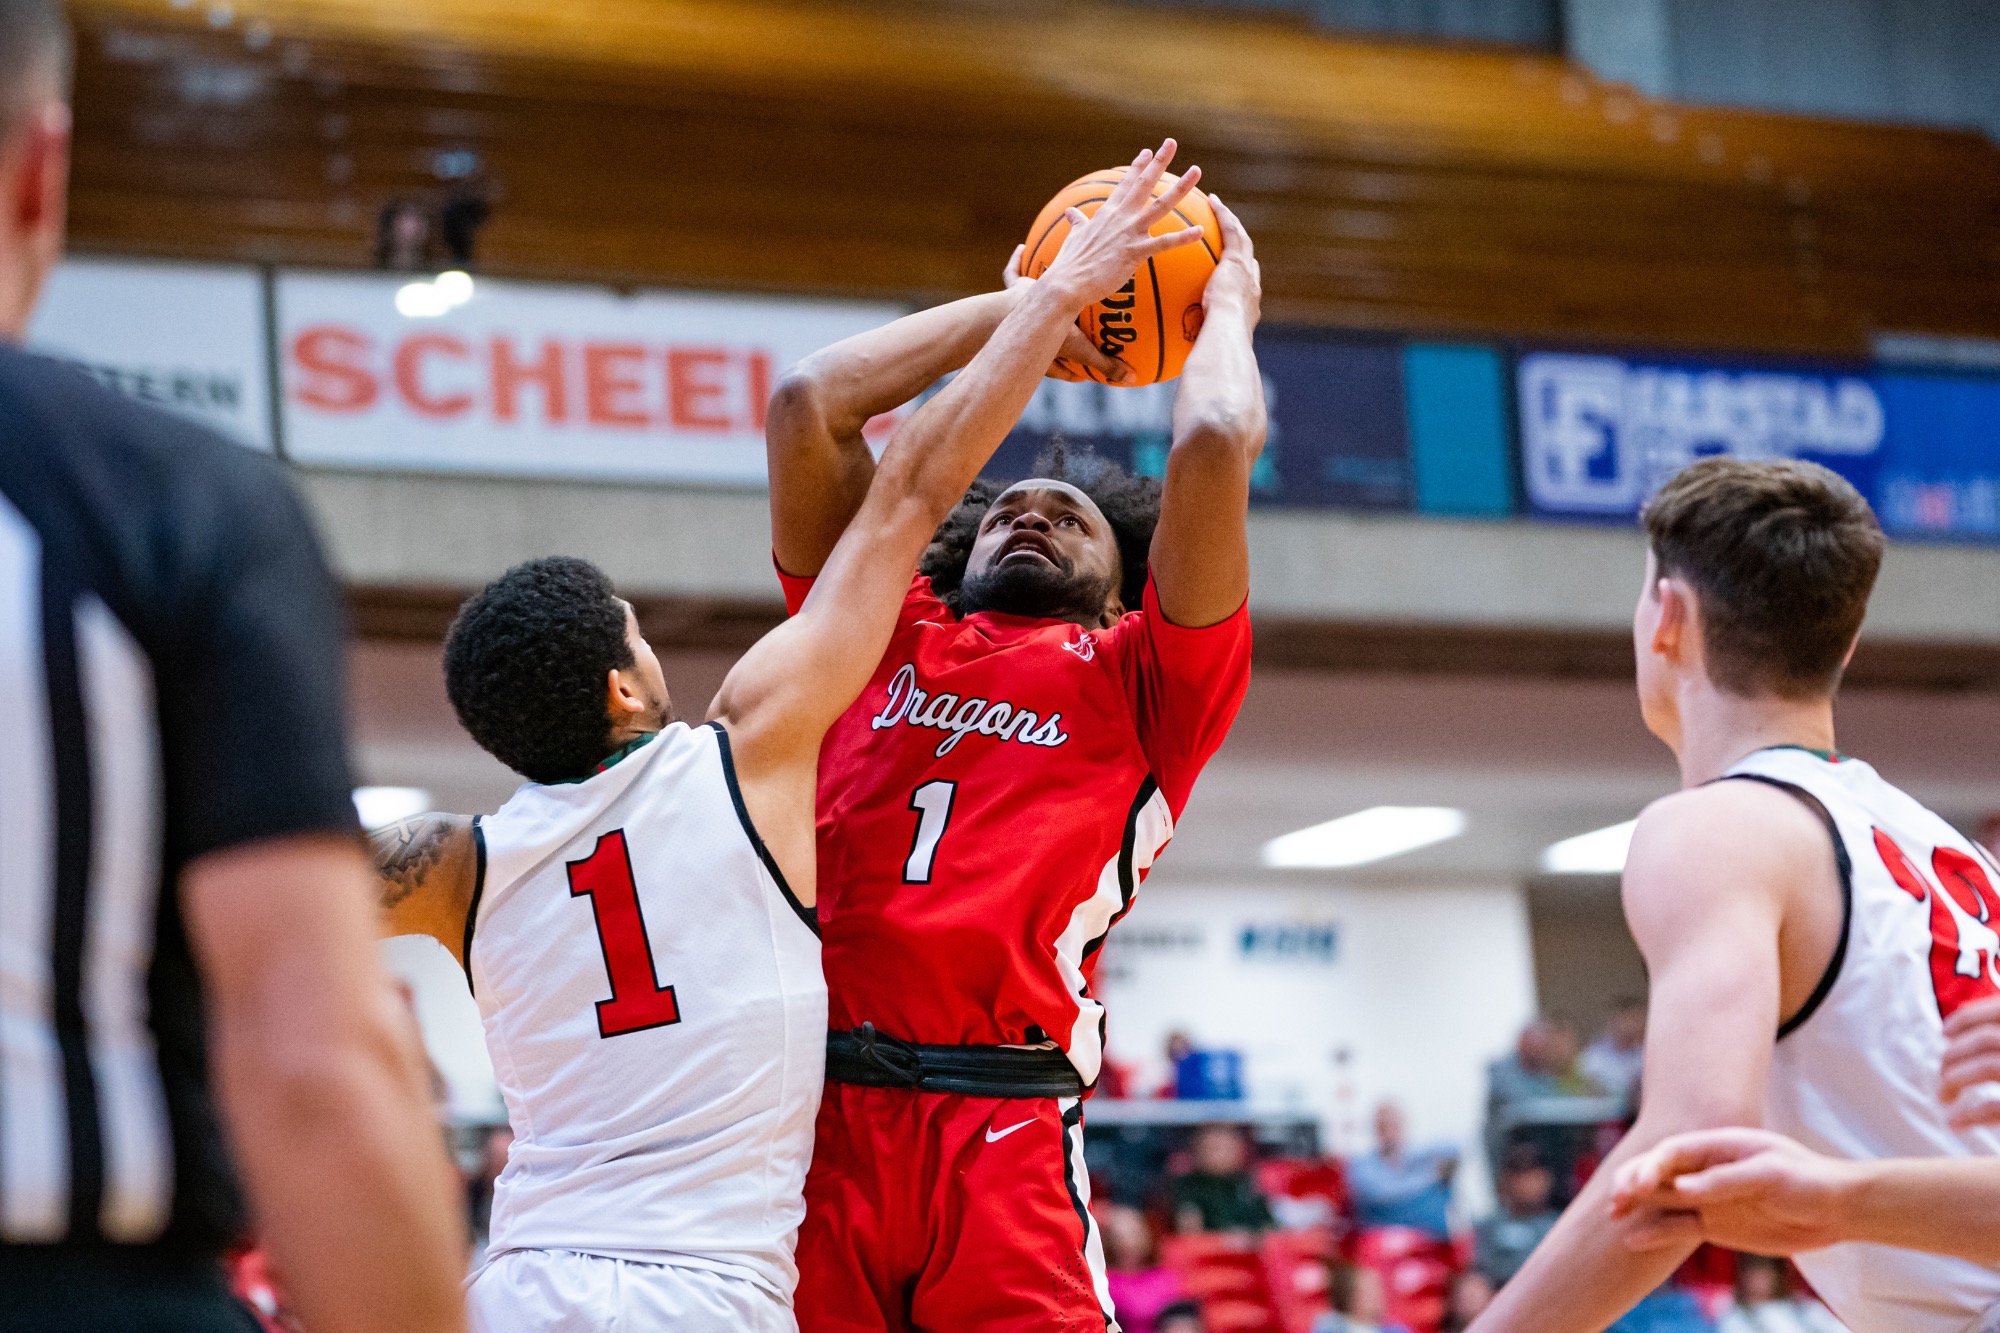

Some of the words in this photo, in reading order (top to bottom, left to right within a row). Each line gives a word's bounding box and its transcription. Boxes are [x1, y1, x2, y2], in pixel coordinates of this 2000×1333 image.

[1098, 268, 1138, 360] Wils
[291, 324, 898, 434] SCHEEL
[871, 662, 1070, 759] Dragons
[902, 778, 959, 884] 1
[566, 828, 681, 1039] 1
